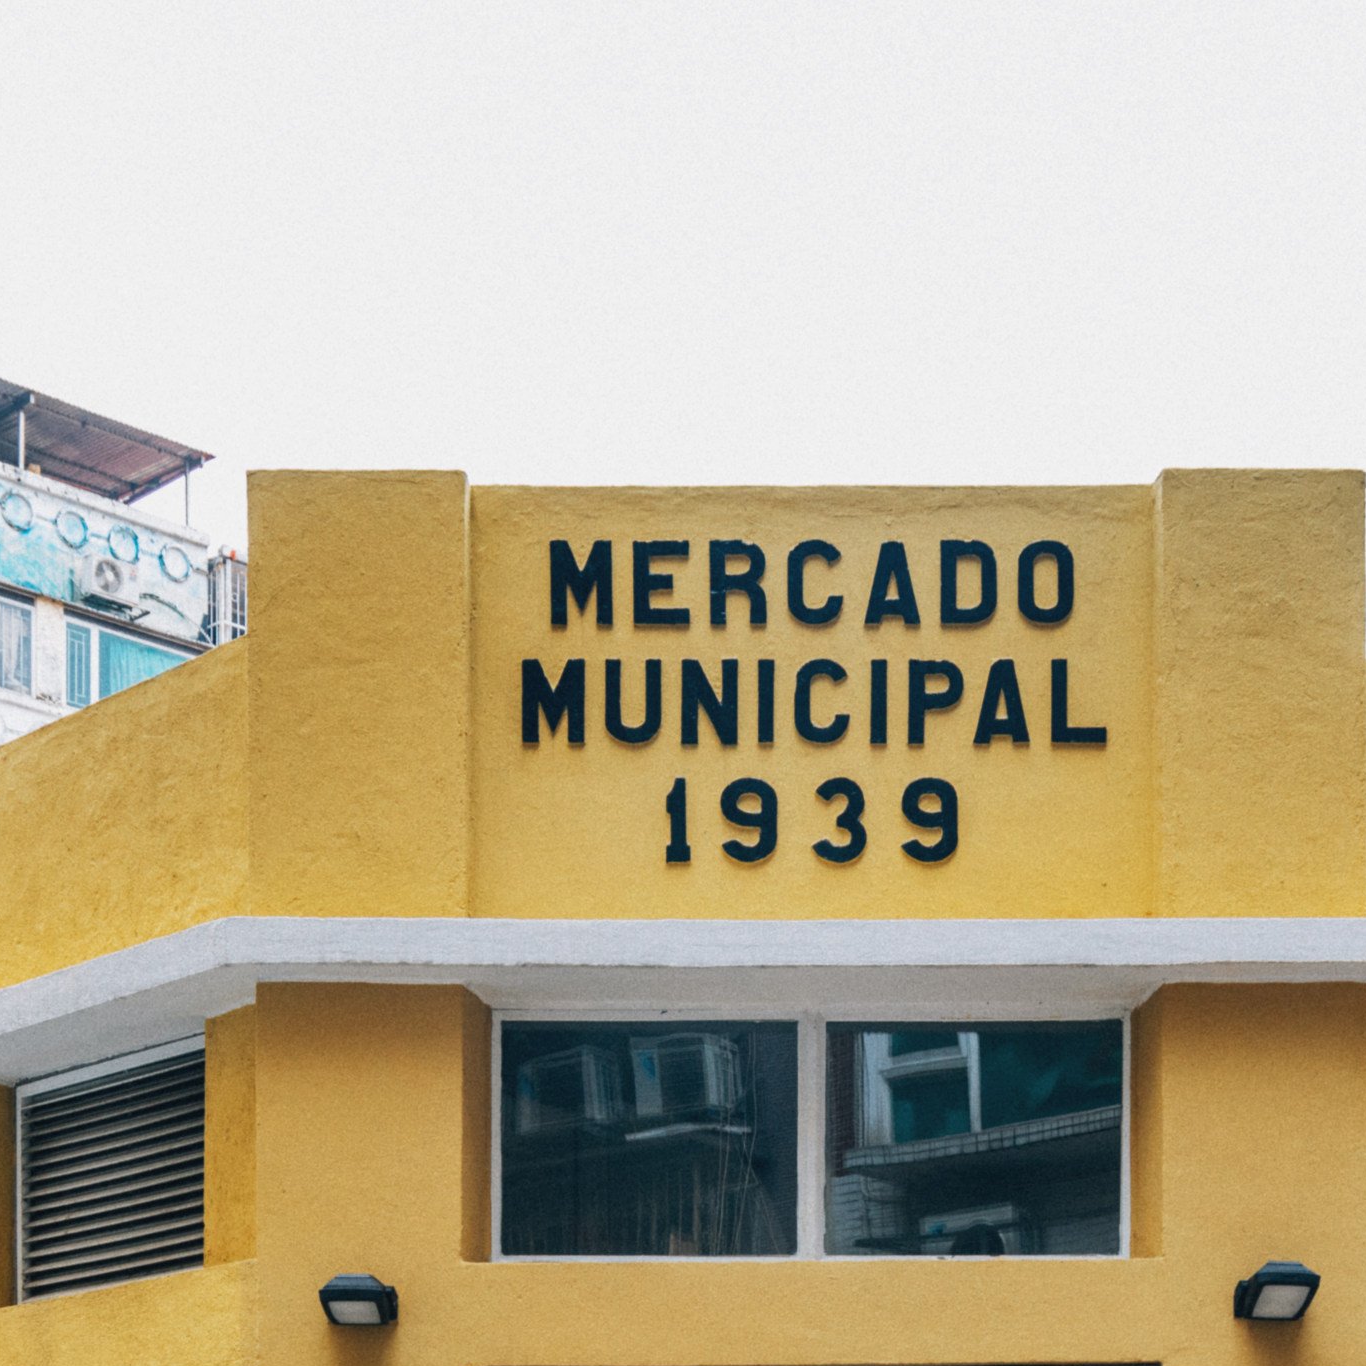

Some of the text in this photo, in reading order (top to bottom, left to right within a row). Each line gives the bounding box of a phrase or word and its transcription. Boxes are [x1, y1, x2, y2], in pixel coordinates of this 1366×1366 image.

[549, 539, 1075, 626] MERCADO
[521, 658, 1108, 746] MUNICIPAL
[665, 776, 960, 864] 1939
